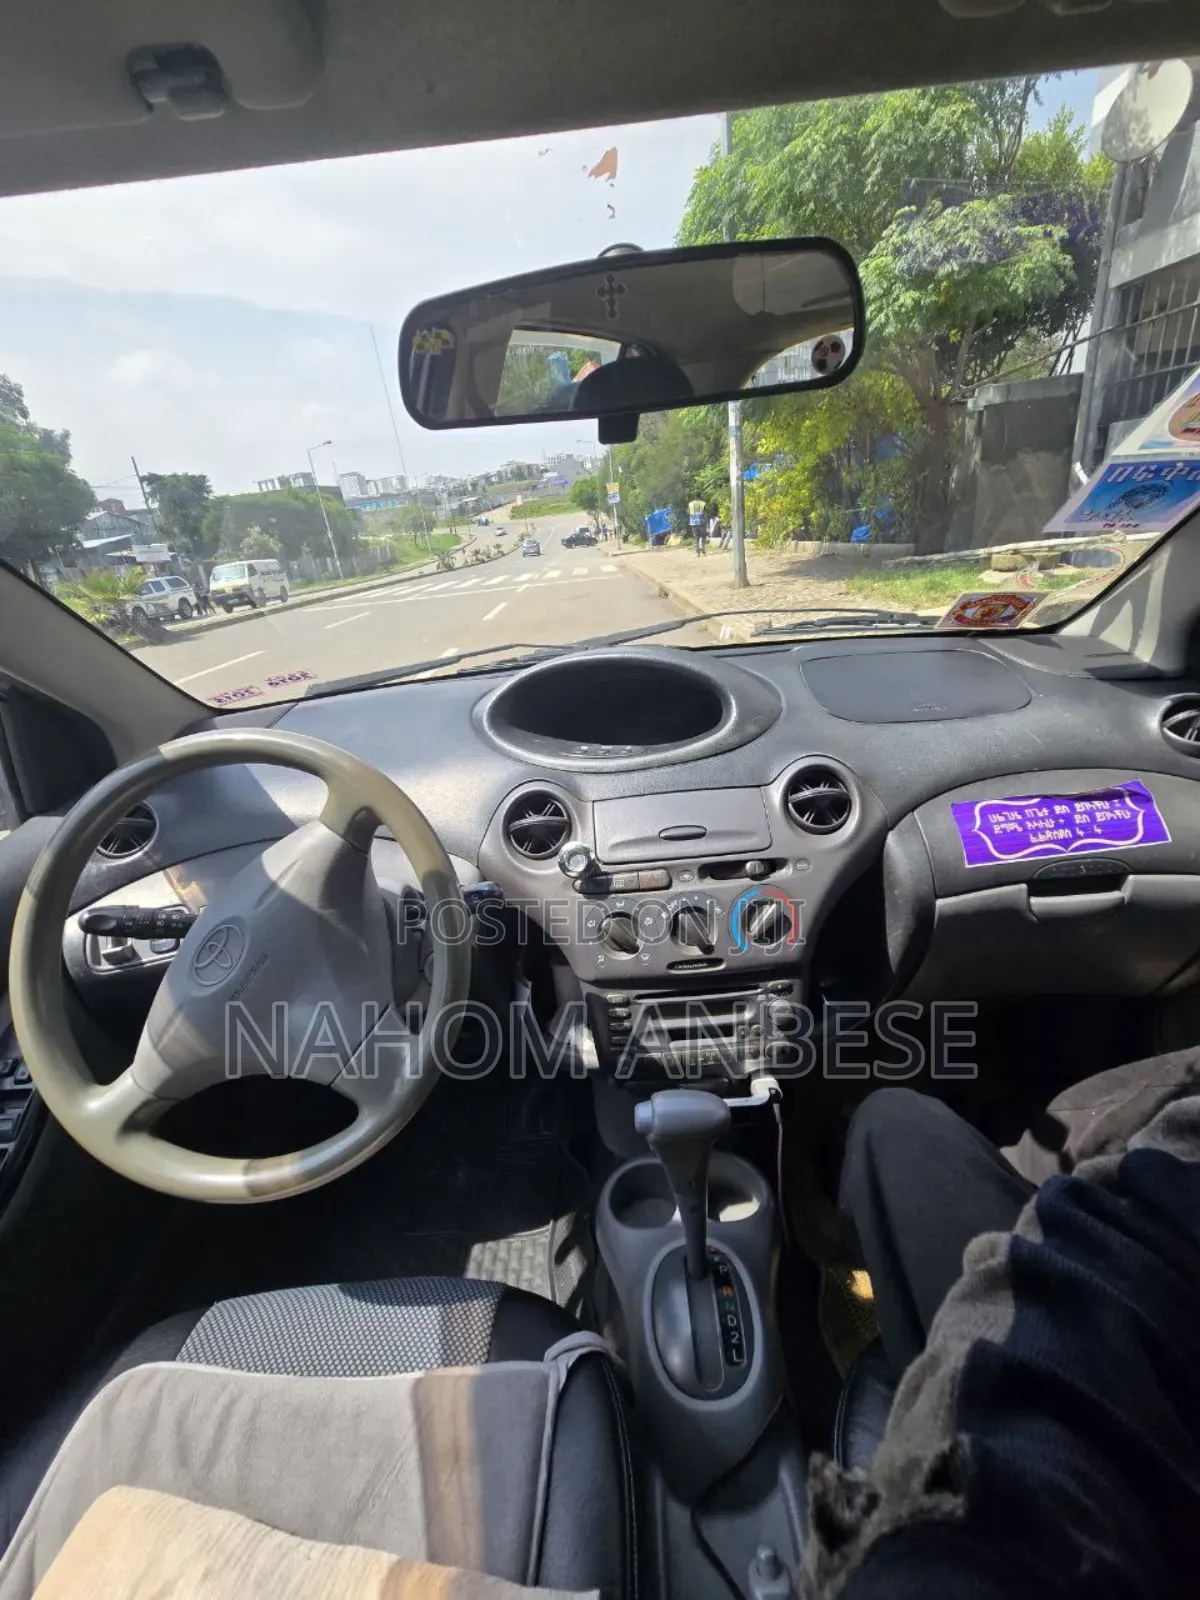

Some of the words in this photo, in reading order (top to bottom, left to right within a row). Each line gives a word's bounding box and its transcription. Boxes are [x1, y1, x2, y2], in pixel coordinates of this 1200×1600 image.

[727, 1314, 737, 1327] D
[730, 1331, 740, 1344] 2
[732, 1349, 743, 1362] L
